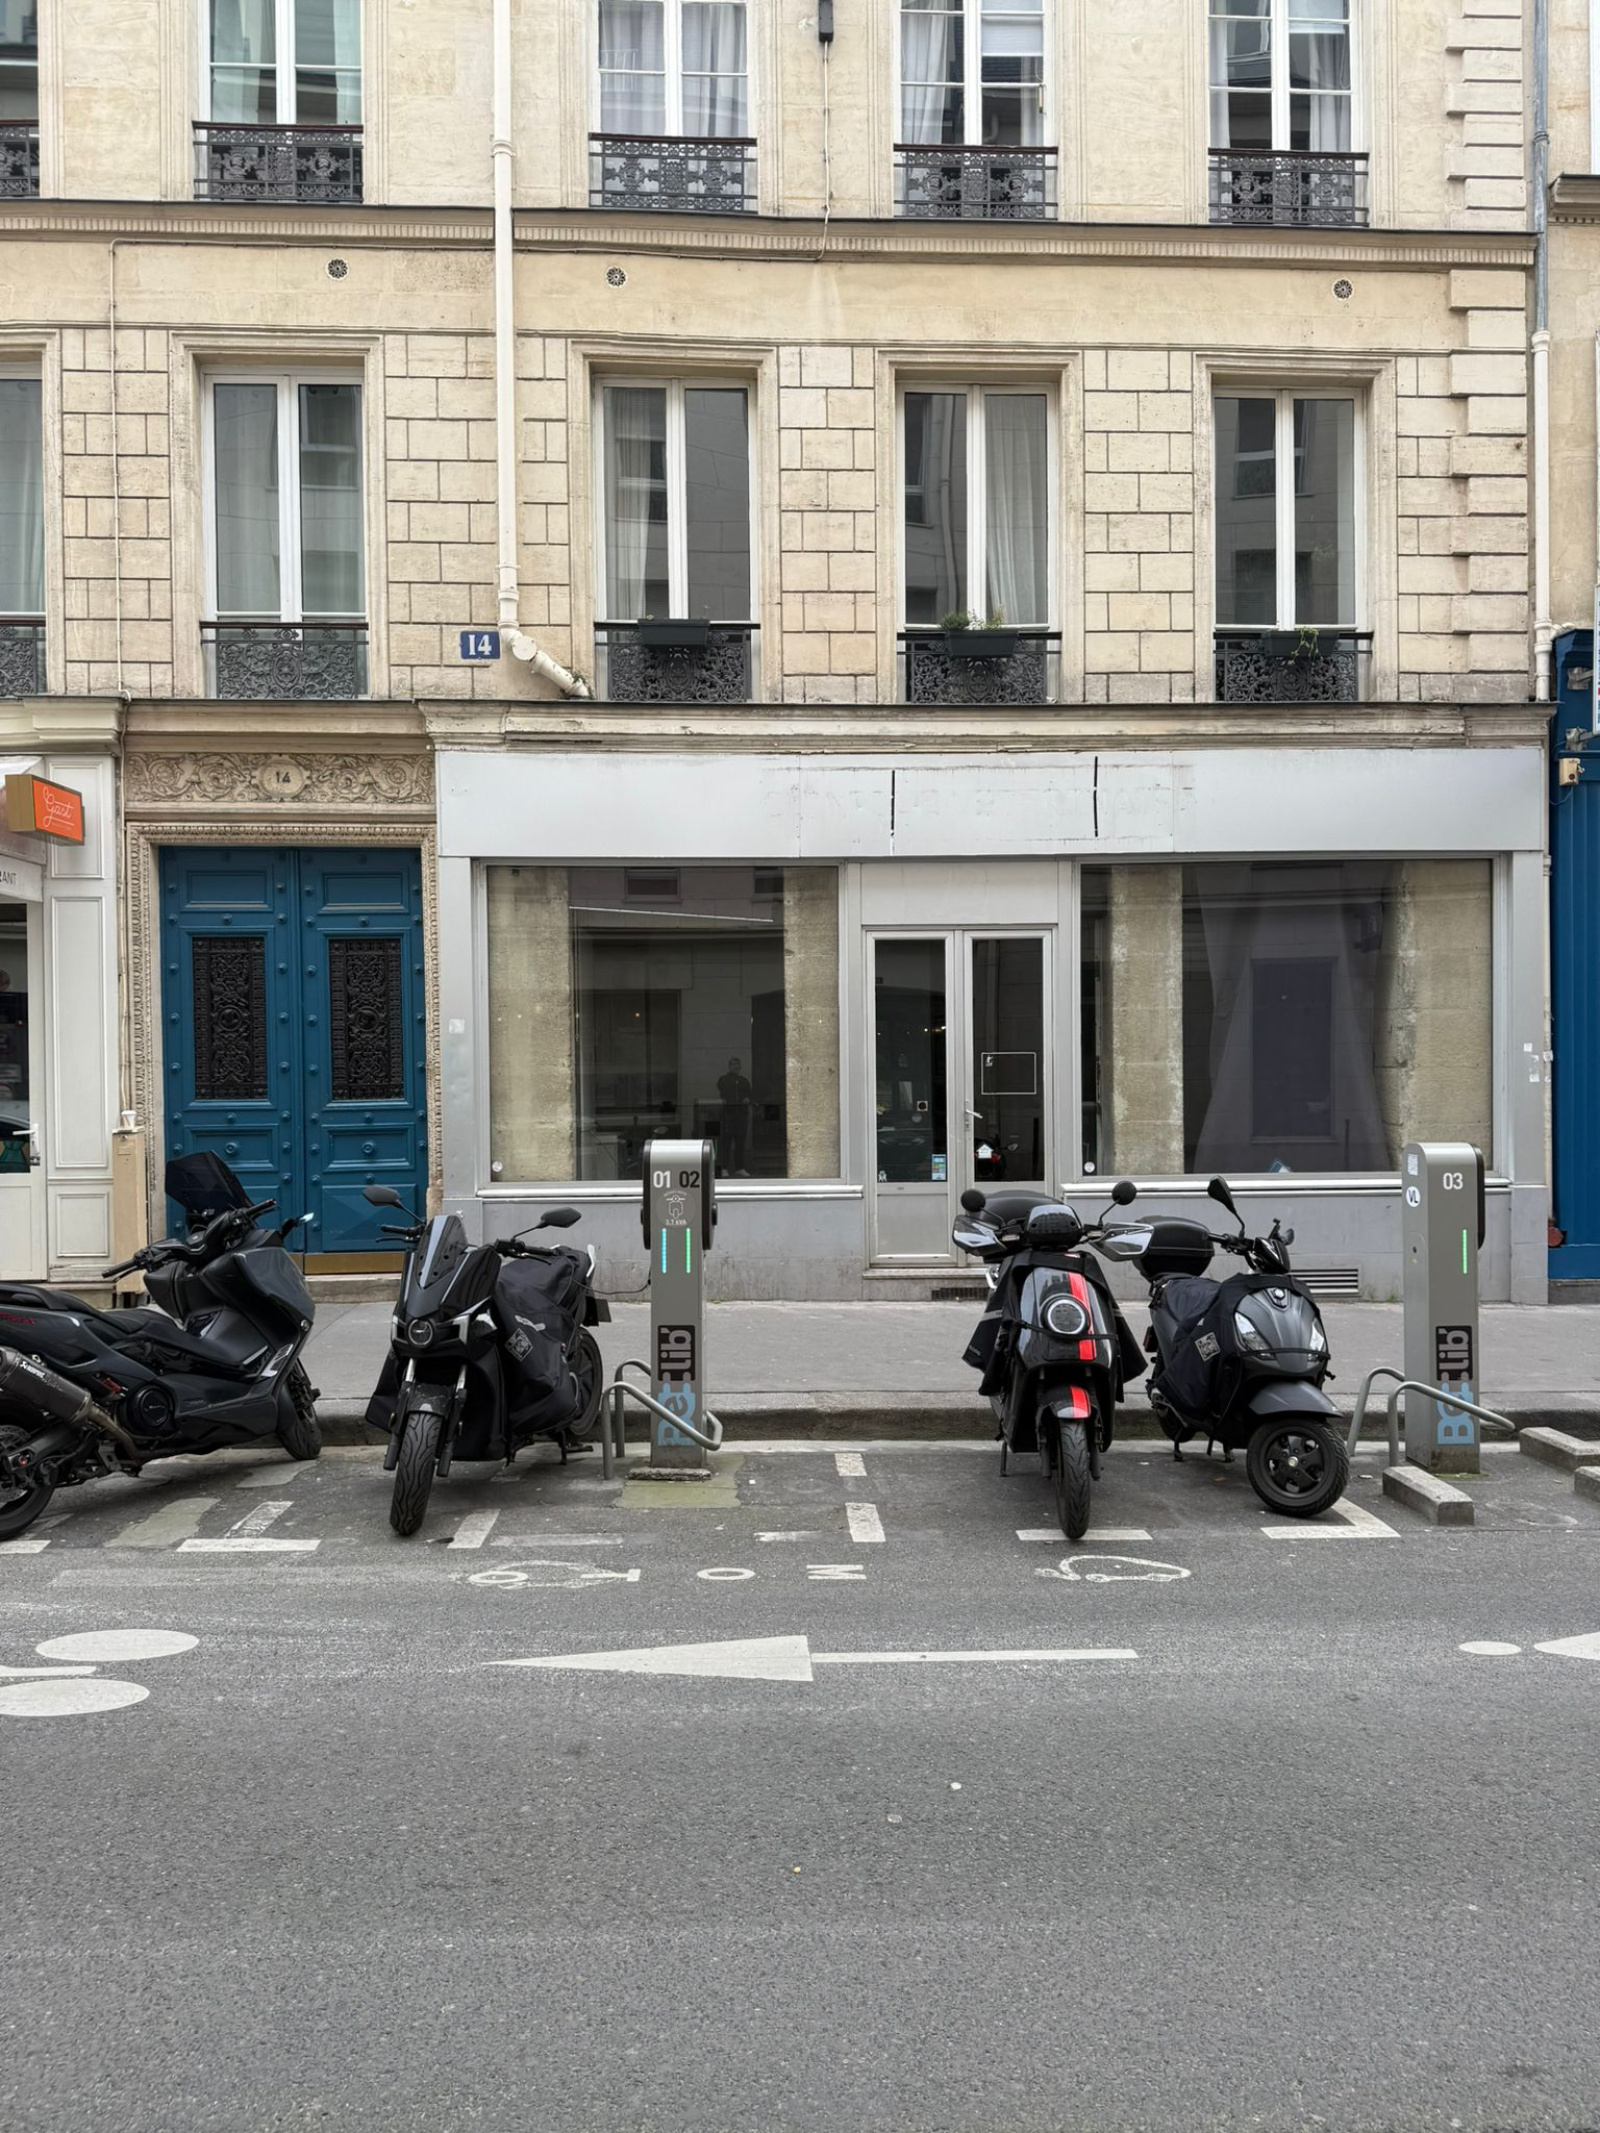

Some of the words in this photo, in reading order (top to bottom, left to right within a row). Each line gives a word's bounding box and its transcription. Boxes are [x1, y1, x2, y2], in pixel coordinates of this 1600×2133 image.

[468, 634, 492, 656] 14
[275, 771, 291, 783] 14
[653, 1170, 671, 1188] 01
[679, 1170, 700, 1188] 02
[1442, 1172, 1464, 1190] 03
[1408, 1189, 1419, 1204] VL
